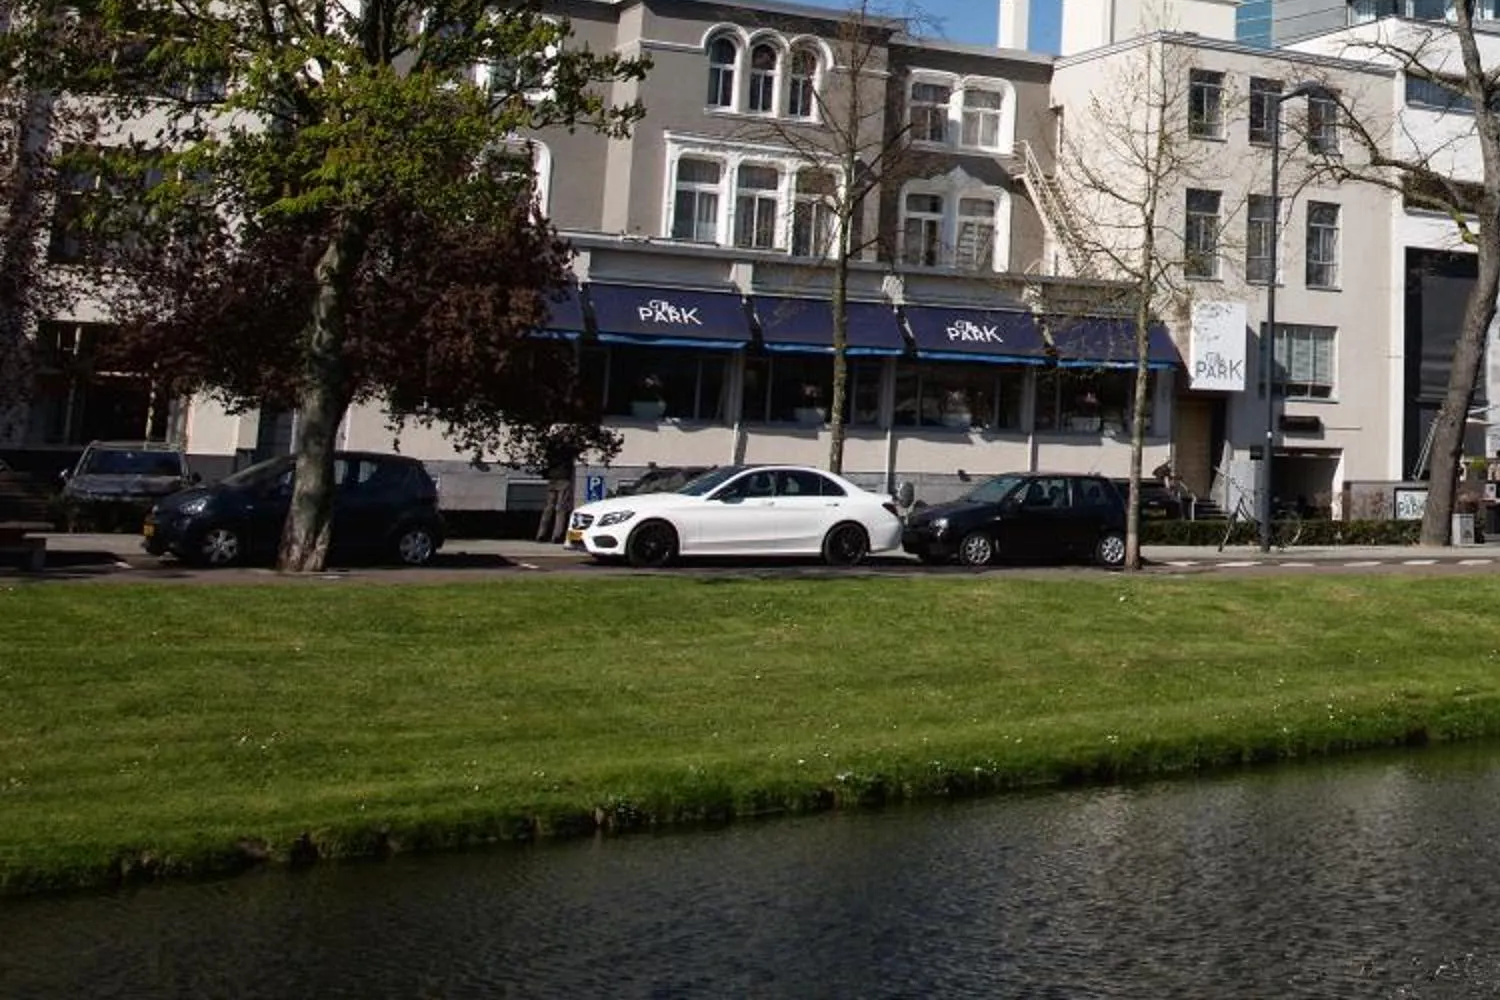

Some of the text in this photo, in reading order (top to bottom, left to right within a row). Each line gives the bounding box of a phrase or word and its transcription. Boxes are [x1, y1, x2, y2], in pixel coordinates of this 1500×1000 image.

[638, 306, 702, 325] PARK
[946, 325, 1004, 343] PARK
[1195, 359, 1243, 381] PARK
